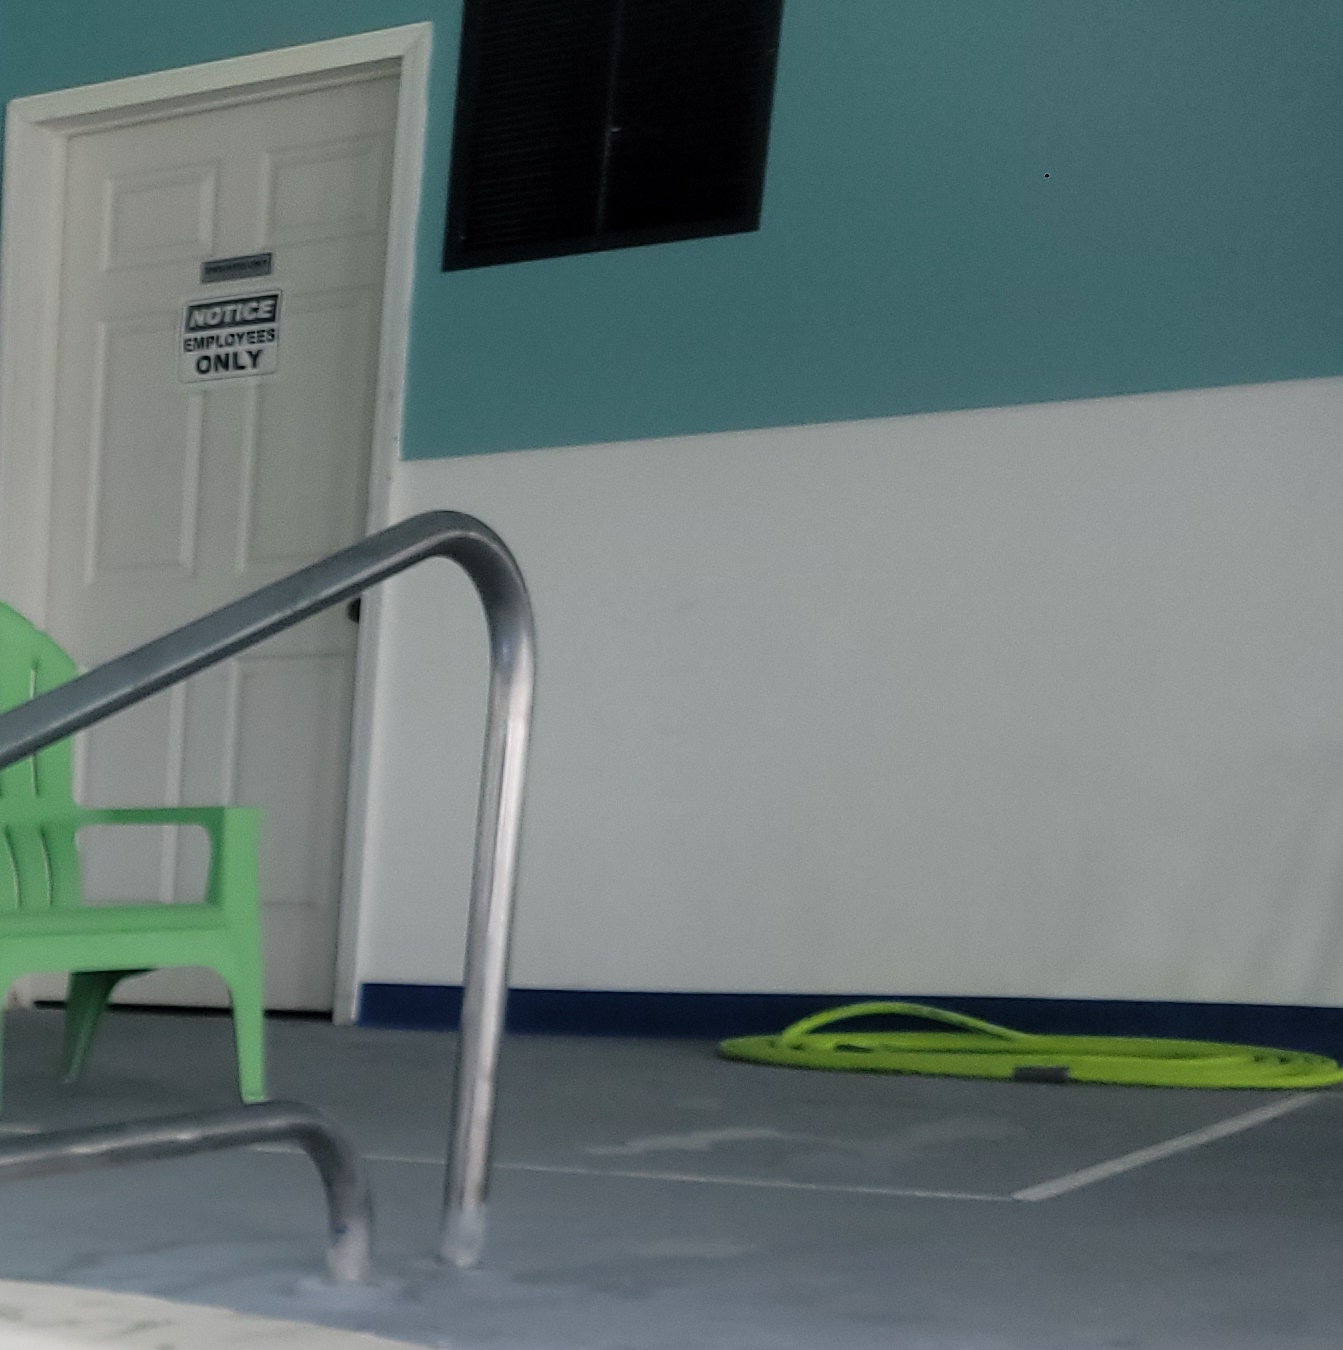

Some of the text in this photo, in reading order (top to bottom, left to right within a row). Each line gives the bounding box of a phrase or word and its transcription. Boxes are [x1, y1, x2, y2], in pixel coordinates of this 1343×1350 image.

[189, 300, 276, 328] NOTICE
[184, 328, 276, 352] EMPLOYEES
[196, 349, 263, 375] ONLY
